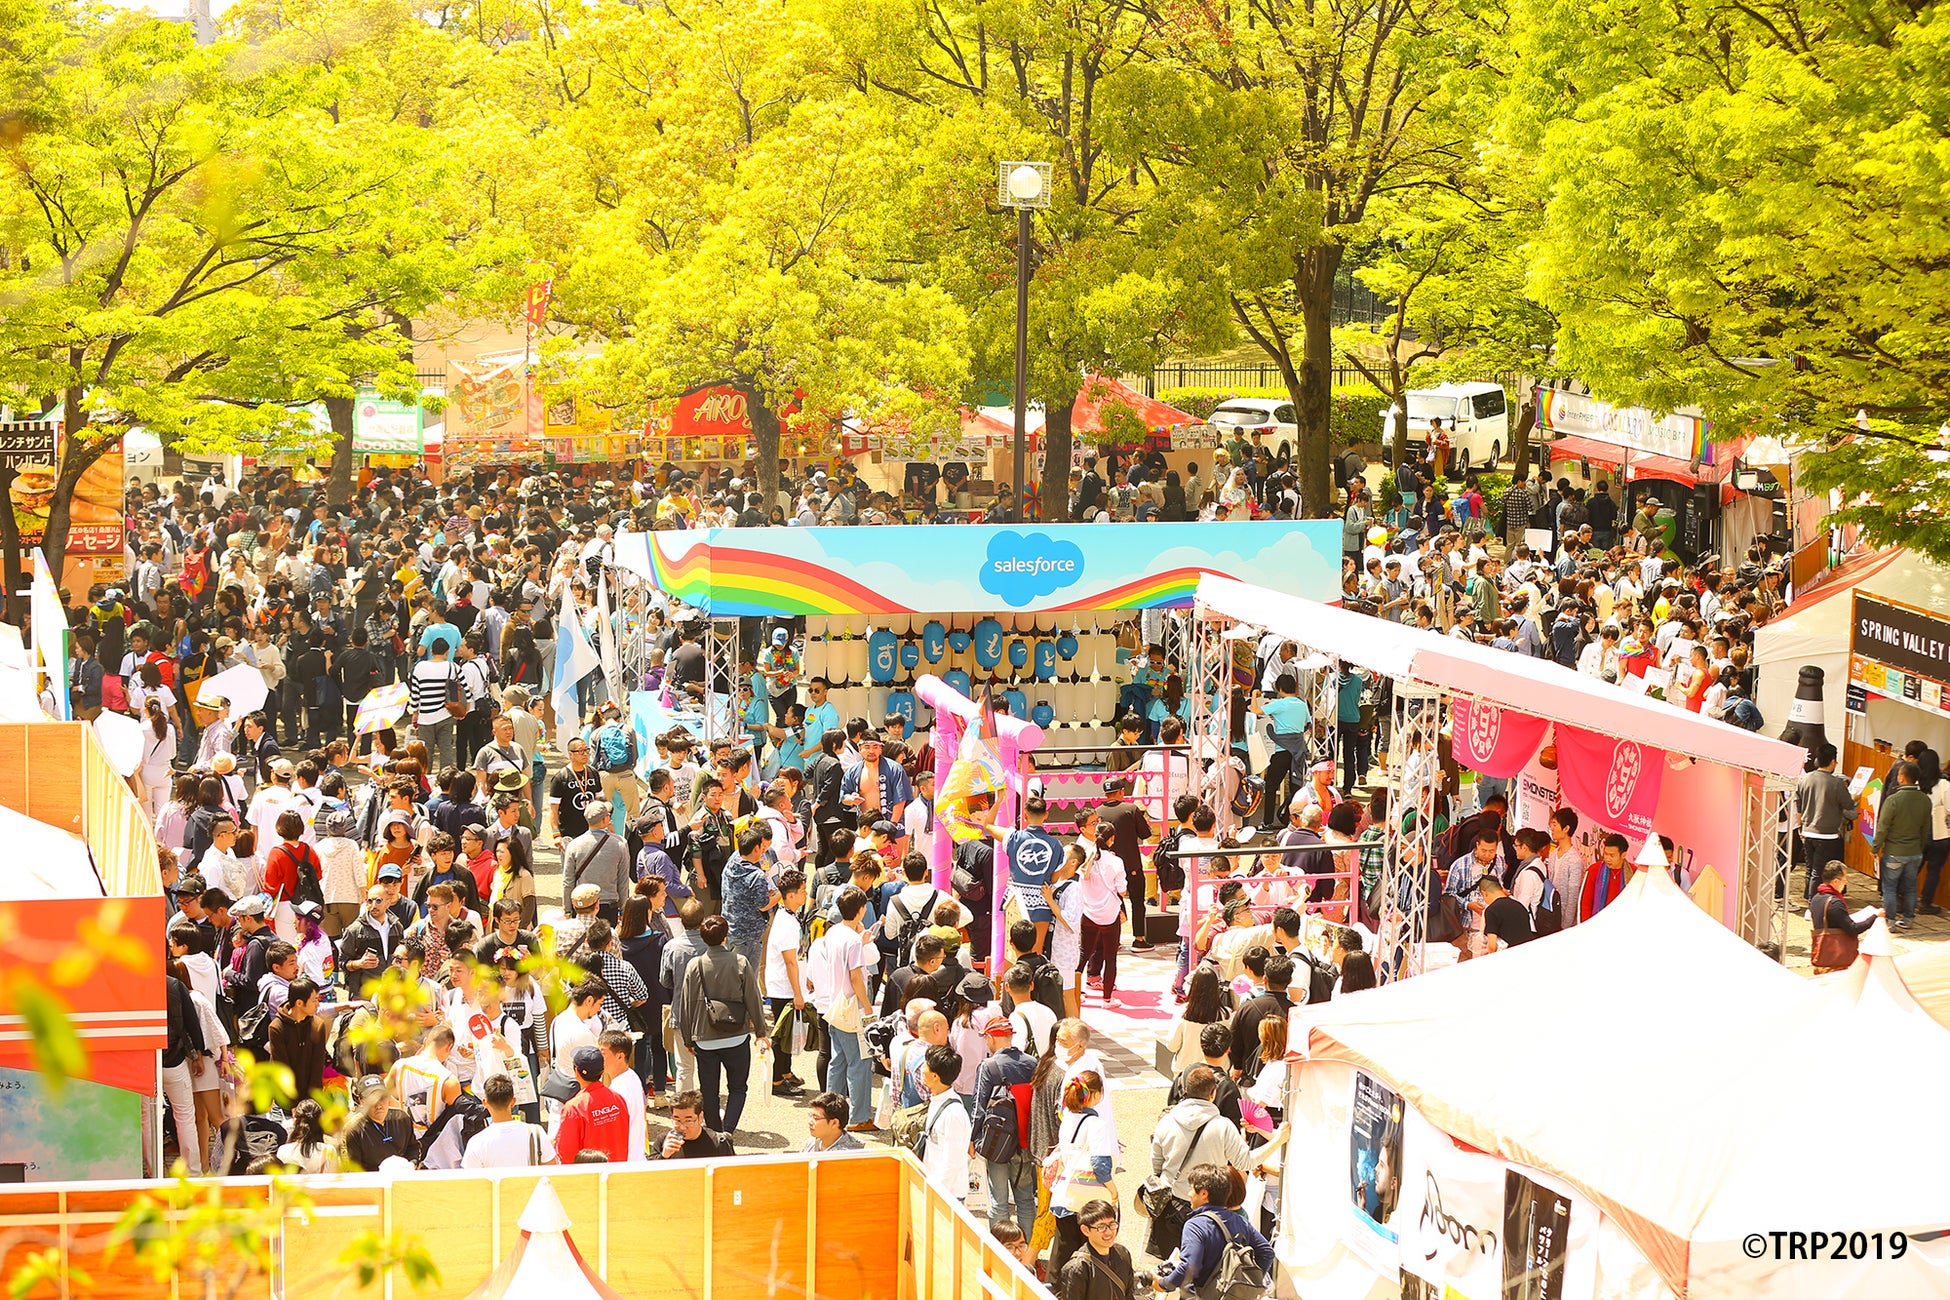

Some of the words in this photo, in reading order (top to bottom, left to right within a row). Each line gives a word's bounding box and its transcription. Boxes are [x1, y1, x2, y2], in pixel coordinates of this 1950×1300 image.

[994, 556, 1075, 577] salesforce
[1860, 618, 1901, 646] SPRING
[1902, 631, 1945, 661] VALLEY
[1523, 778, 1557, 803] 9MONSTER
[591, 1104, 620, 1118] TENGA
